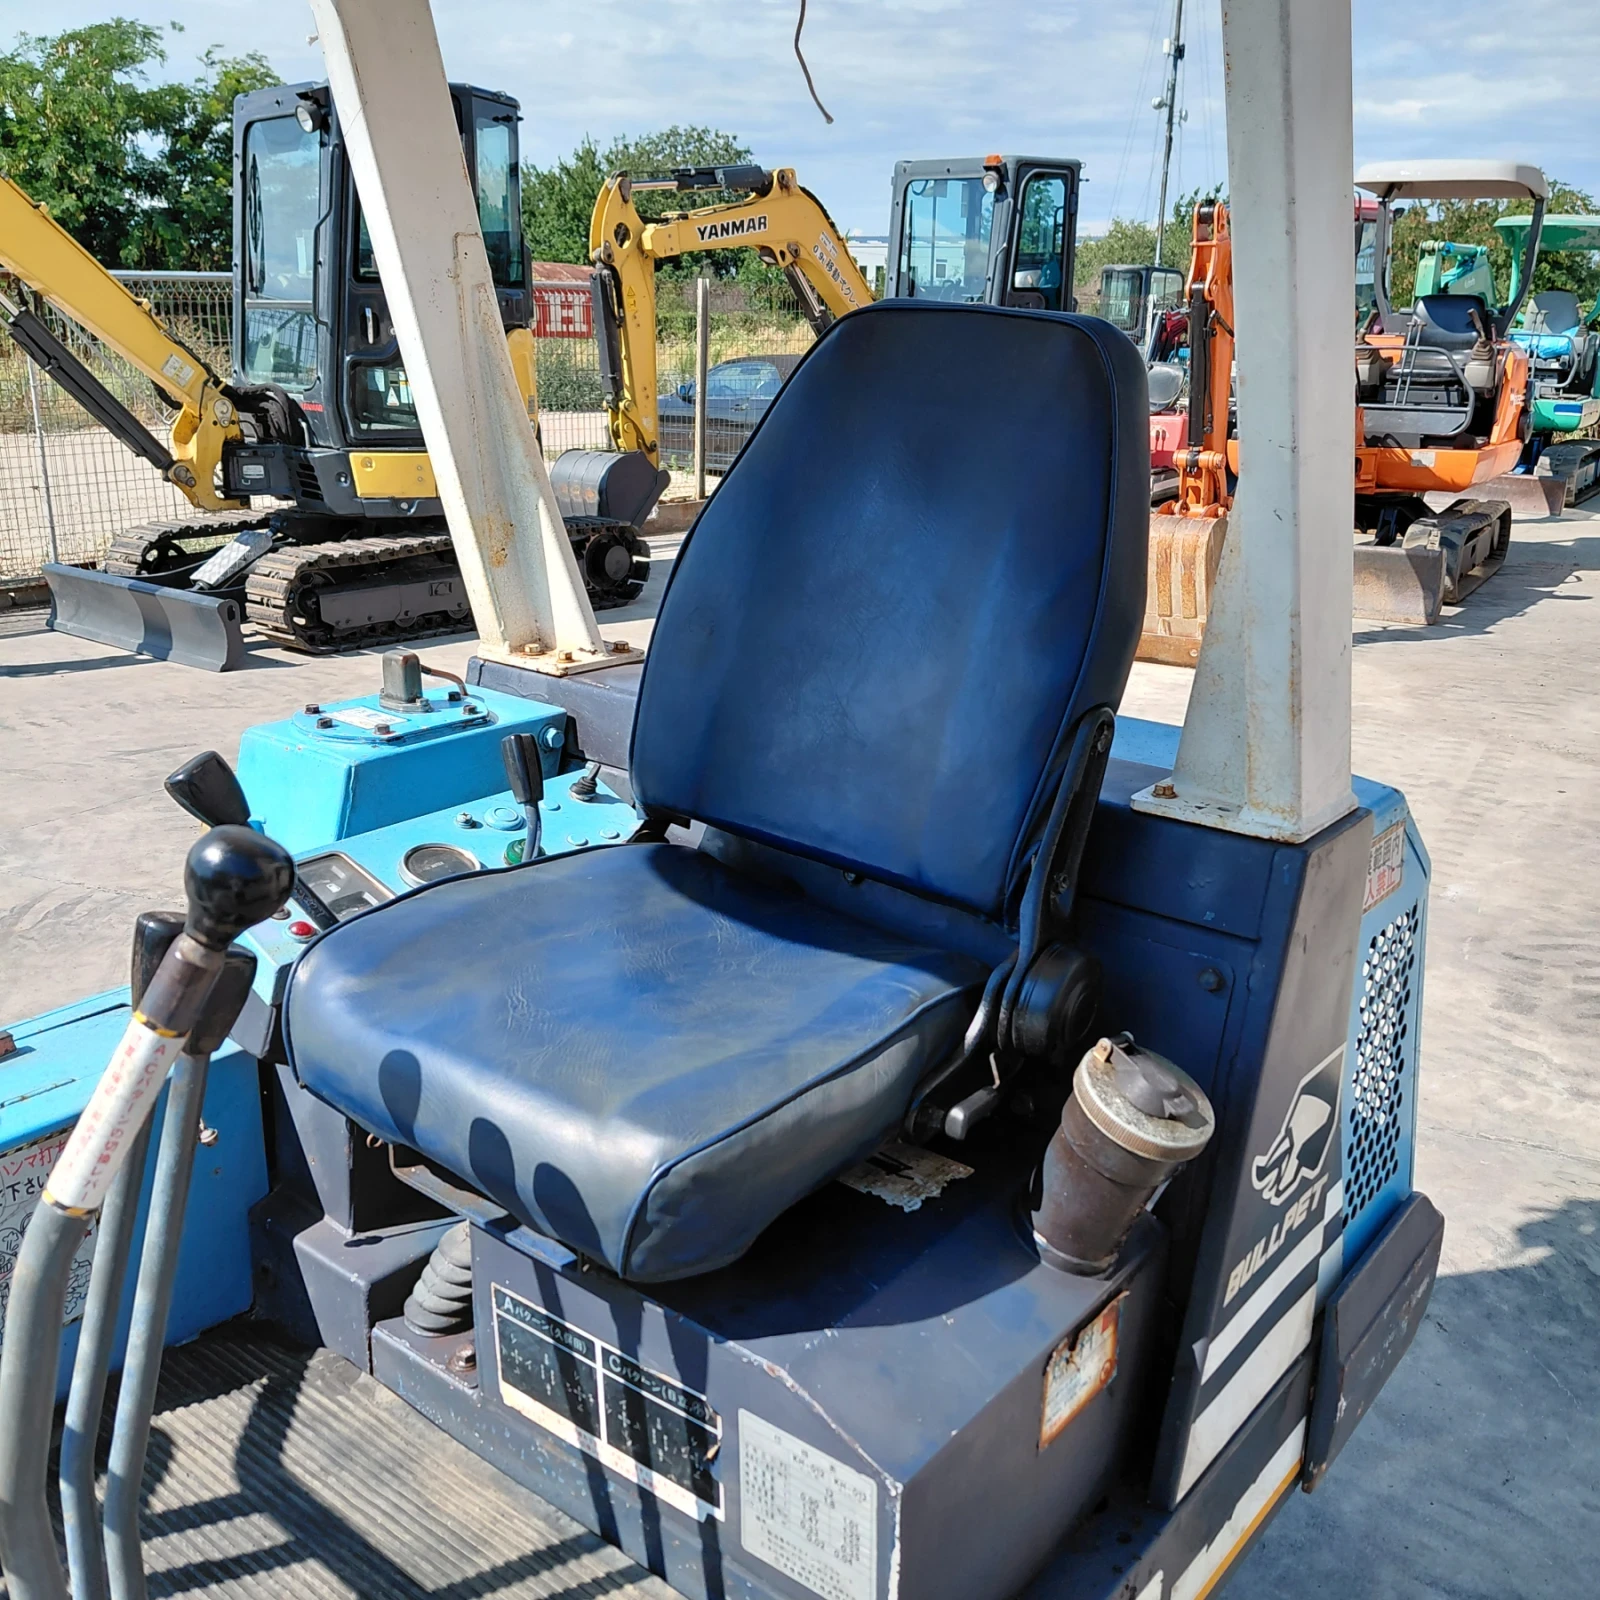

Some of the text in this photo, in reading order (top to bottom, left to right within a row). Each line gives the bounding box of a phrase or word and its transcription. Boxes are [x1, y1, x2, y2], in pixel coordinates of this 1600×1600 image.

[697, 214, 768, 242] YANMAR
[0, 1172, 50, 1206] 下さい
[1223, 1173, 1329, 1308] BULLPET
